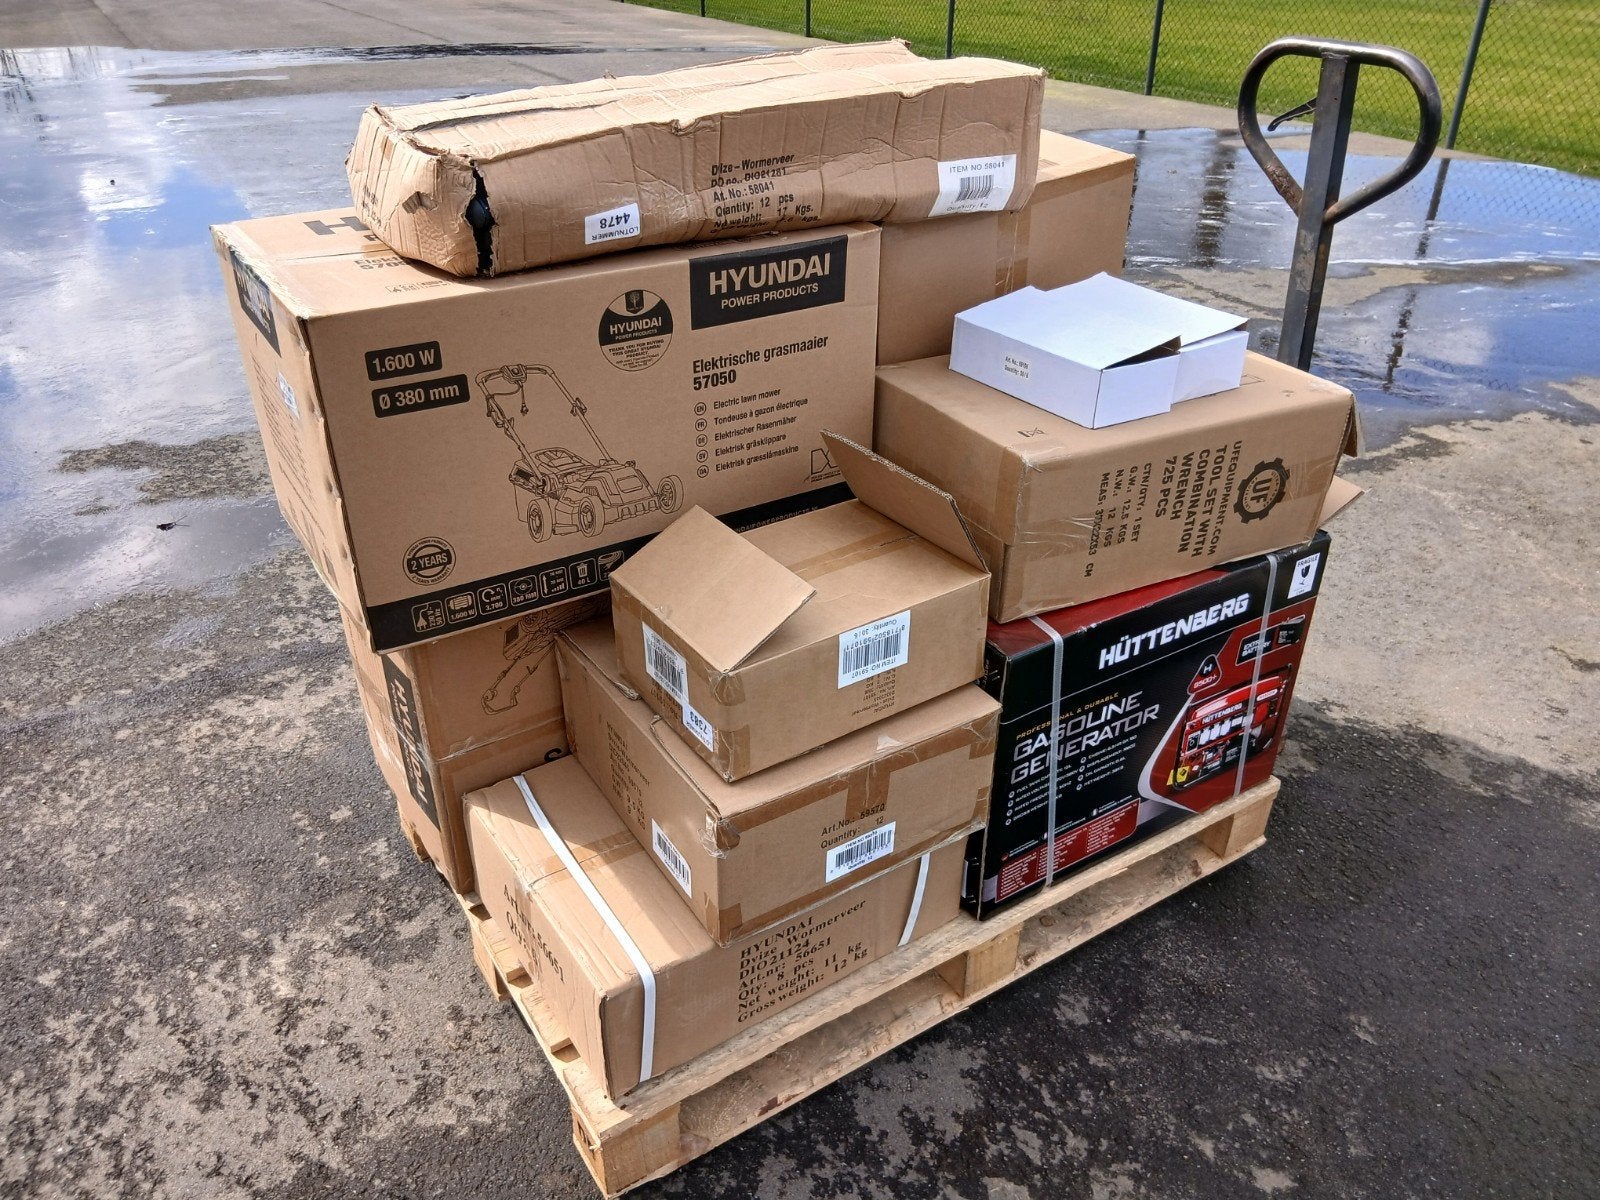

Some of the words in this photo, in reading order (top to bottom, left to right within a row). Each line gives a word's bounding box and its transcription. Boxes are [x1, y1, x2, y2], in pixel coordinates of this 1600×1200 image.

[748, 181, 775, 194] 58041
[760, 197, 770, 208] 12
[779, 193, 794, 206] pcs
[592, 226, 638, 240] LOTNUMMER
[600, 213, 630, 229] 4478
[710, 252, 830, 295] HYUNDAI
[722, 293, 760, 309] POWER
[763, 283, 819, 302] PRODUCTS
[610, 317, 662, 334] HYUNDAI
[373, 353, 415, 373] 1.600
[419, 349, 435, 365] W
[693, 350, 760, 374] Elektrische
[764, 336, 828, 362] grasmaaier
[693, 369, 737, 390] 57050
[395, 389, 425, 407] 380
[430, 384, 460, 400] mm
[714, 398, 739, 410] Electric
[741, 395, 756, 403] lawn
[759, 388, 781, 399] mower
[714, 411, 747, 426] Tondeuse
[755, 406, 774, 417] gazon
[776, 398, 808, 412] électrique
[715, 426, 754, 441] Elektrischer
[756, 416, 797, 431] Rasenmäher
[715, 444, 744, 456] Elektrisk
[716, 458, 744, 472] Elektrisk
[1161, 455, 1178, 485] 725
[1209, 445, 1228, 486] TOOL
[1099, 472, 1110, 506] MEAS:
[1113, 469, 1124, 497] N.W.:
[1126, 466, 1138, 494] G.W.:
[1136, 463, 1152, 511] CTN/QTY:
[1170, 452, 1194, 521] WRENCH
[1250, 478, 1272, 503] UF
[1121, 499, 1130, 521] 12.5
[1155, 488, 1171, 518] PCS
[1178, 449, 1210, 554] COMBINATION
[1203, 489, 1218, 516] SET
[1207, 440, 1242, 556] UFEQUIPMENT.COM
[1107, 508, 1116, 520] 12
[1103, 527, 1114, 548] KGS
[1117, 524, 1128, 544] KGS
[1191, 518, 1210, 558] WITH
[411, 561, 418, 570] 2
[419, 553, 448, 568] YEARS
[1084, 563, 1094, 578] CM
[1298, 555, 1318, 567] FRAGILE
[451, 611, 467, 620] 1.600
[1099, 592, 1250, 670] HÜTTENBERG
[1203, 664, 1212, 674] H
[1085, 692, 1119, 710] DURABLE
[689, 711, 708, 735] 7383
[1014, 691, 1143, 761] GASOLINE
[1011, 704, 1160, 784] GENERATOR
[820, 827, 860, 848] Quantity:
[876, 816, 883, 825] 12
[740, 946, 777, 969] Dvize
[787, 900, 866, 946] Wormerveer
[741, 916, 812, 959] HYUNDAI
[738, 963, 786, 991] Art.nr:
[795, 936, 831, 962] 56651
[739, 939, 810, 980] DIO21124
[738, 997, 760, 1013] Net
[768, 968, 814, 996] weight:
[824, 954, 837, 967] 11
[848, 941, 862, 955] kg
[738, 981, 767, 1000] Qty:
[777, 972, 785, 981] 8
[793, 958, 814, 974] pcs
[738, 998, 776, 1023] Gross
[778, 973, 824, 1001] weight:
[834, 959, 847, 973] 12
[854, 948, 868, 961] kg
